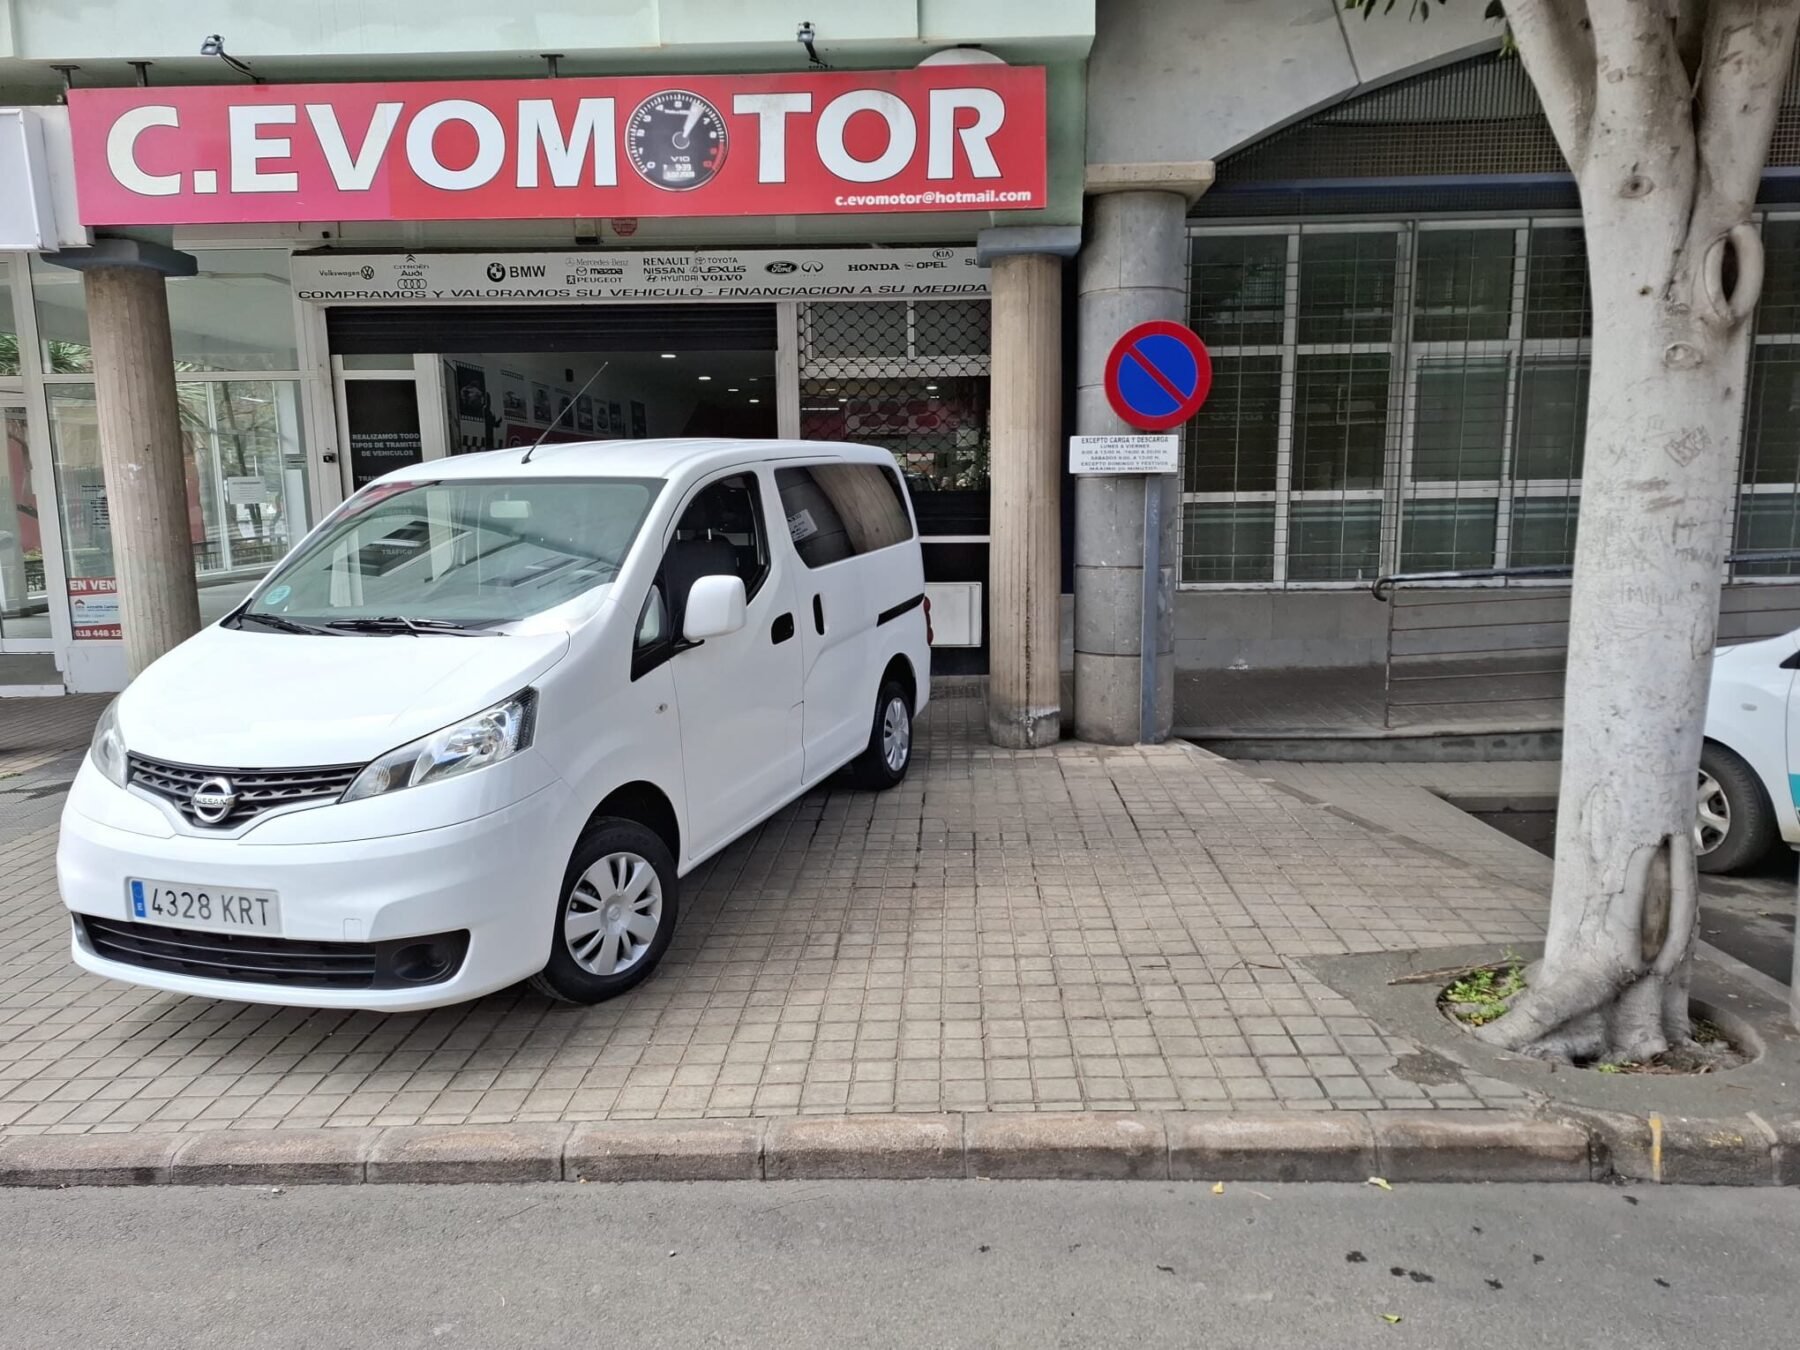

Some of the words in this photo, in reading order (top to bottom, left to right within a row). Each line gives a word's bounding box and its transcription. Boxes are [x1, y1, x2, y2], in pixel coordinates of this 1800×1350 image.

[835, 189, 1031, 206] c.evomotor@hotmail.com
[936, 250, 950, 258] KIA
[576, 257, 629, 266] Mercedes-Benz
[643, 257, 690, 266] RENAULT
[916, 261, 947, 269] OPEL
[509, 265, 546, 279] BMW
[643, 267, 685, 275] NISSAN
[699, 265, 747, 274] LEXUS
[848, 263, 900, 272] HONDA
[319, 269, 360, 278] Volkswagen
[701, 274, 743, 282] VOLVO
[577, 276, 623, 284] PEUGEOT
[298, 290, 426, 299] COMPRAMOS
[432, 290, 444, 298] Y
[451, 288, 570, 298] VALORAMOS
[576, 288, 601, 297] SU
[610, 288, 704, 298] VEHICULO
[718, 286, 855, 296] FINANCIACION
[859, 286, 873, 294] A
[878, 285, 905, 293] SU
[912, 284, 987, 294] MEDIDA
[69, 580, 87, 591] EN
[195, 797, 230, 806] NISSAN
[151, 887, 212, 920] 4328
[220, 894, 270, 926] KRT
